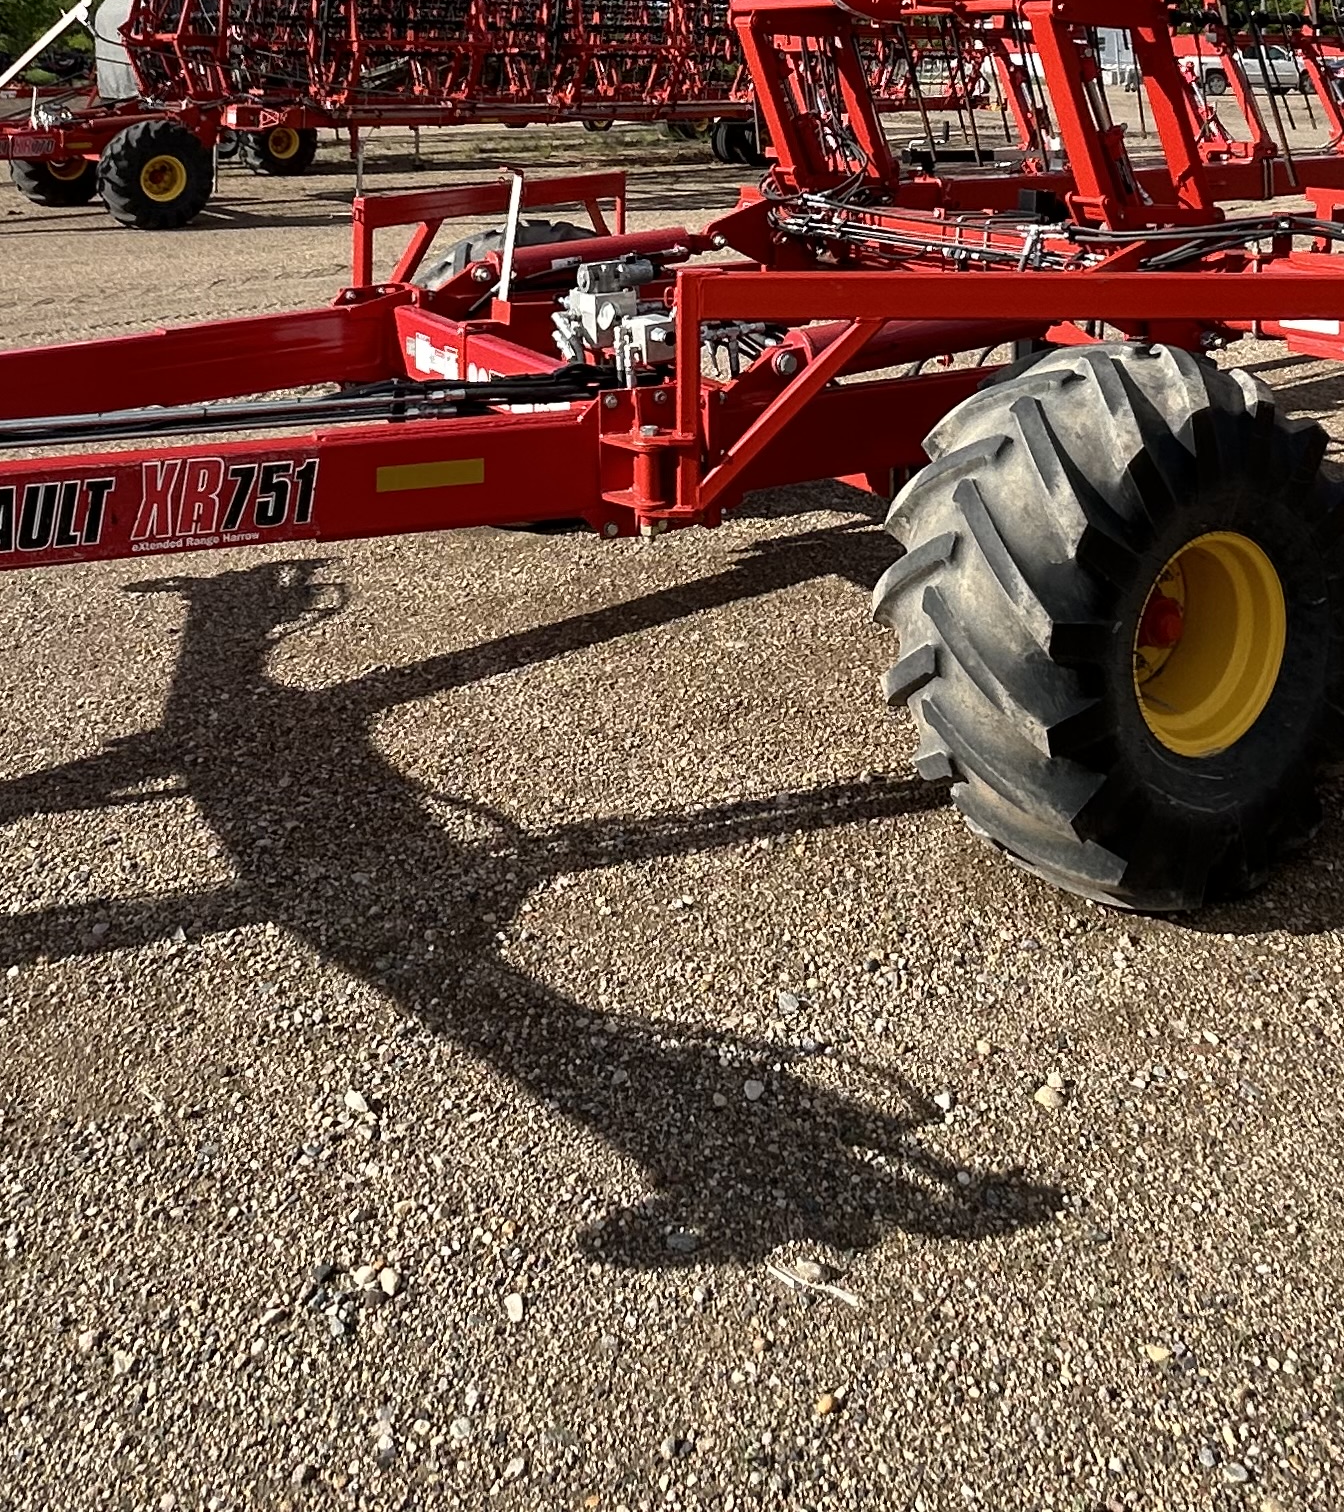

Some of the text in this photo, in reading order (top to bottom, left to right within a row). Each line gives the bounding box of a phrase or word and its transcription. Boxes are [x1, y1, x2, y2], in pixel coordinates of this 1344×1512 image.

[130, 456, 320, 541] XR751
[131, 531, 260, 552] eXtended Range Harrow
